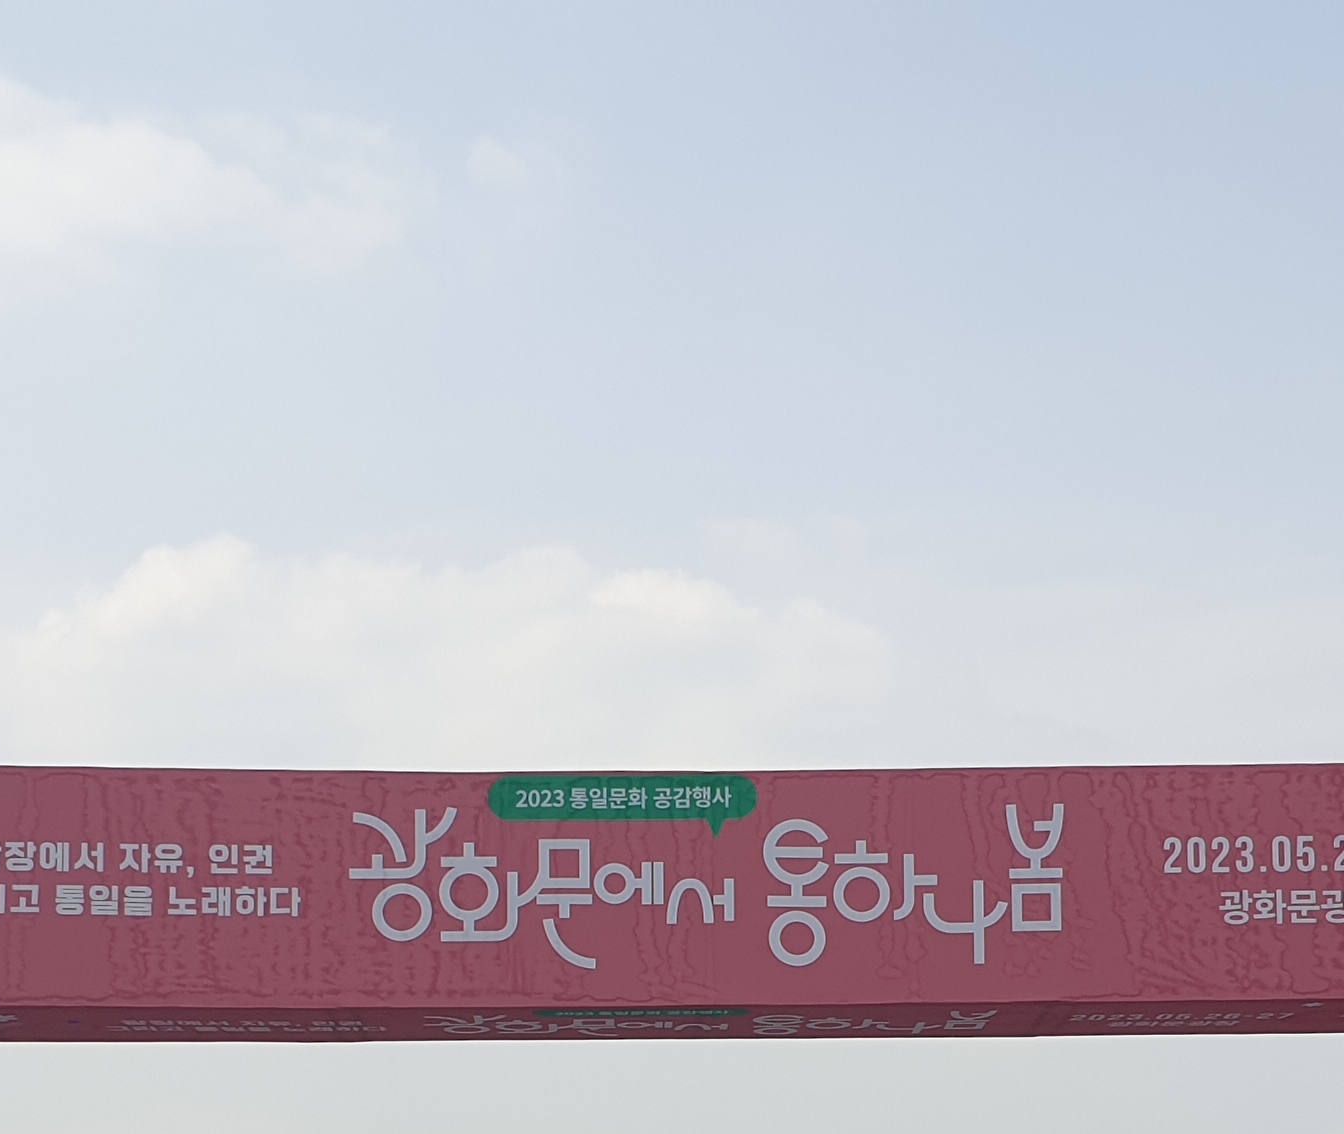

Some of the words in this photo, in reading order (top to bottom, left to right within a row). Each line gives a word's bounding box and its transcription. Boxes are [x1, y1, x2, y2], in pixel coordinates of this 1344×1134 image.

[515, 788, 565, 809] 2023
[569, 786, 649, 810] 통일문화
[653, 786, 732, 810] 공감행사
[119, 842, 196, 880] 자유,
[209, 842, 274, 877] 인권
[54, 882, 154, 917] 통일을
[166, 884, 302, 918] 노래하다
[348, 806, 735, 969] 광화문에서
[763, 802, 1065, 967] 통하나봄
